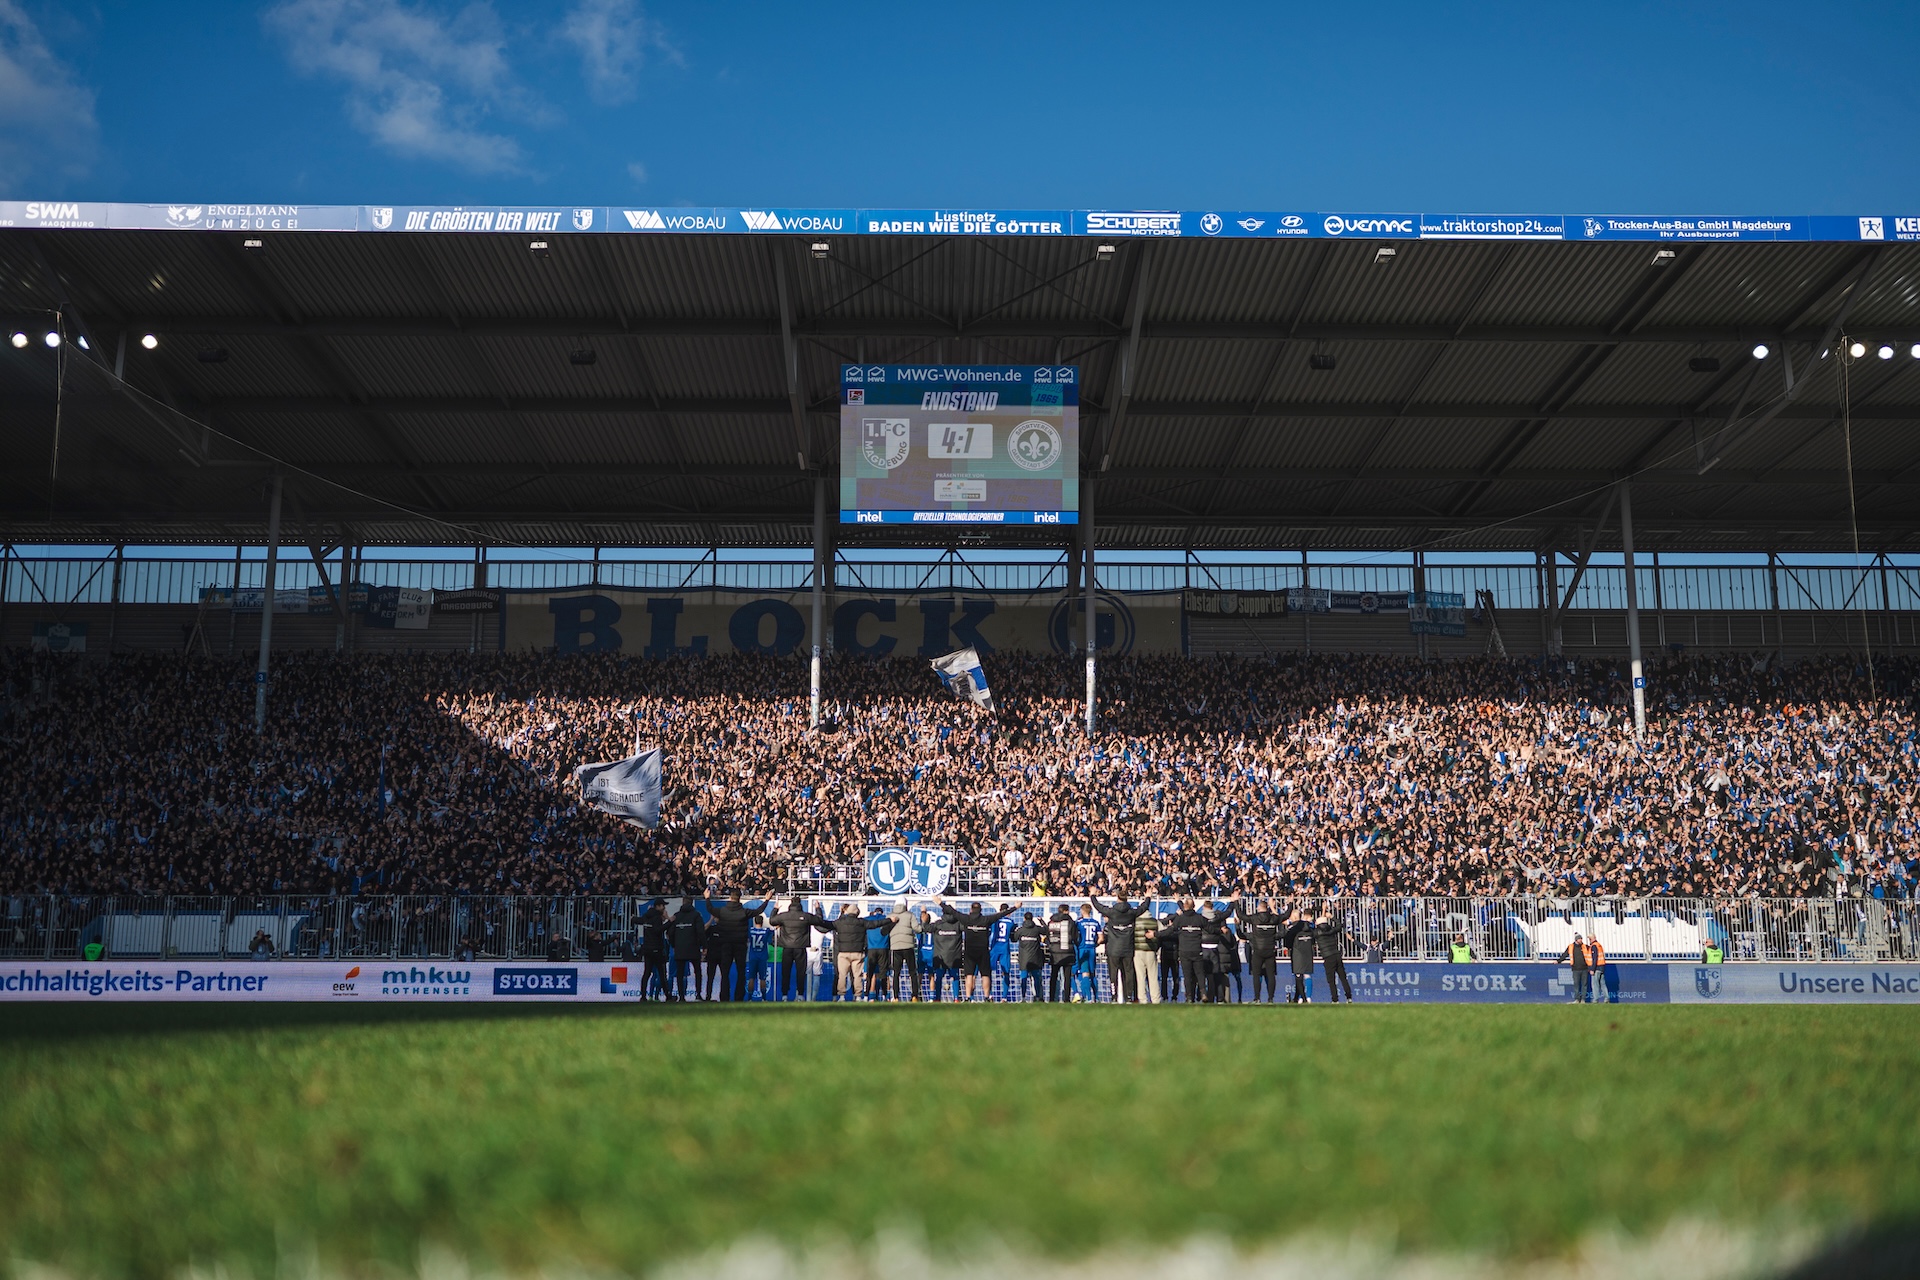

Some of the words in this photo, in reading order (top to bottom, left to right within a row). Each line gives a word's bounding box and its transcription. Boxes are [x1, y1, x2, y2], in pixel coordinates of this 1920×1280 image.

[25, 203, 79, 219] SWM
[208, 205, 298, 216] ENGELMANN
[935, 211, 996, 223] Lustinetz
[40, 220, 95, 228] MAGDEBURG
[404, 211, 430, 230] DIE
[497, 212, 522, 230] DER
[525, 212, 561, 230] WELT
[666, 216, 726, 229] WOBAU
[783, 217, 843, 230] WOBAU
[869, 221, 927, 233] BADEN
[929, 221, 959, 233] WIE
[967, 222, 994, 233] DIE
[996, 219, 1062, 233] GÖTTER
[1087, 213, 1180, 230] SCHUBERT
[1420, 219, 1562, 235] www.traktorshop24.com
[1608, 220, 1695, 230] Trocken-Aus-Bau
[1697, 221, 1729, 230] GmbH
[1732, 221, 1791, 231] Magdeburg
[897, 368, 1022, 381] MWG-Wohnen.de
[920, 392, 999, 411] ENDSTAND
[1015, 423, 1054, 436] SPORTVEREIN
[941, 427, 974, 454] 4:1
[865, 440, 908, 467] MAGDEBURG
[380, 610, 415, 619] REFORM
[554, 597, 996, 656] BLOCK
[258, 673, 264, 682] 3
[911, 868, 947, 895] MAGDEBURG
[998, 922, 1007, 937] 3
[1084, 925, 1096, 940] 16
[751, 935, 765, 949] 14
[382, 966, 471, 984] mhkw
[500, 974, 572, 989] STORK
[333, 983, 355, 991] eew
[1442, 974, 1527, 992] STORK
[1779, 972, 1865, 994] Unsere
[382, 987, 470, 995] ROTHENSEE
